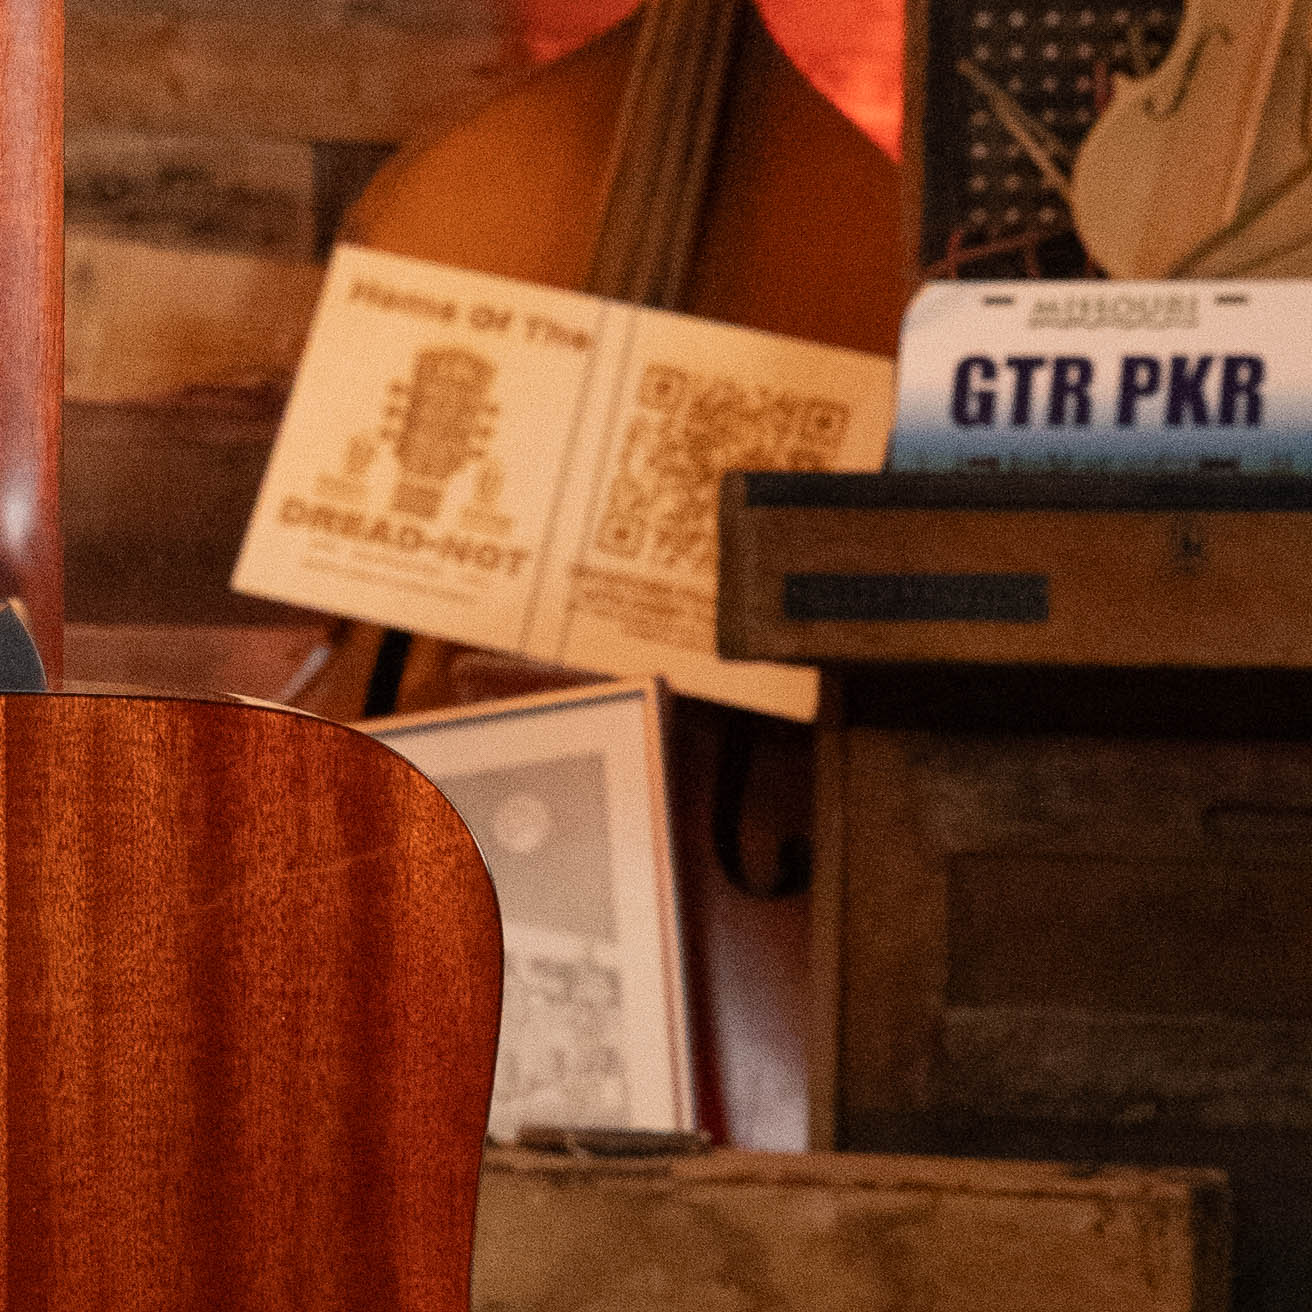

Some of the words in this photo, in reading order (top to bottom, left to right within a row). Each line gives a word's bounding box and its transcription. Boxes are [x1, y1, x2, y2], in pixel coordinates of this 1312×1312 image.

[951, 354, 1093, 428] GTR
[1118, 354, 1267, 428] PKR
[279, 494, 529, 576] DREAD-NOT
